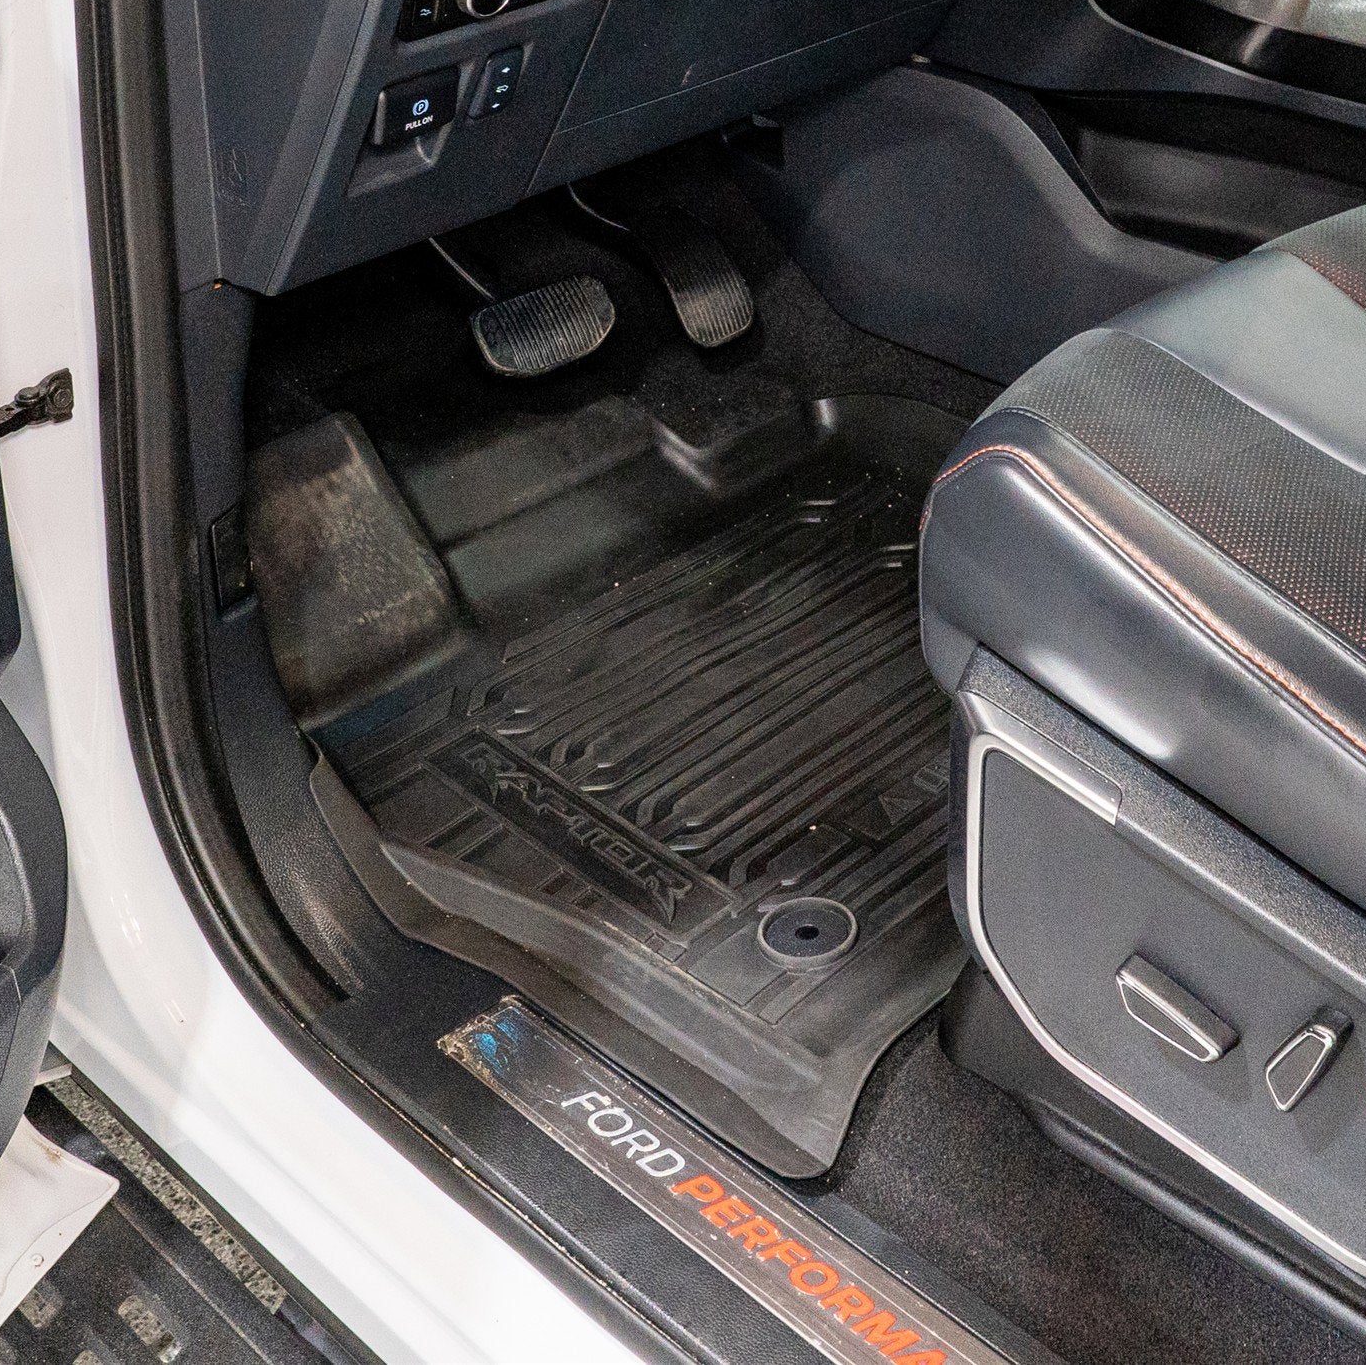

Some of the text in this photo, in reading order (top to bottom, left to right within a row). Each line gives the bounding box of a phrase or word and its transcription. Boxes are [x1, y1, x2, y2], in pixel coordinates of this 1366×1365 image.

[405, 115, 434, 131] PULL ON
[561, 1090, 686, 1177] FORD
